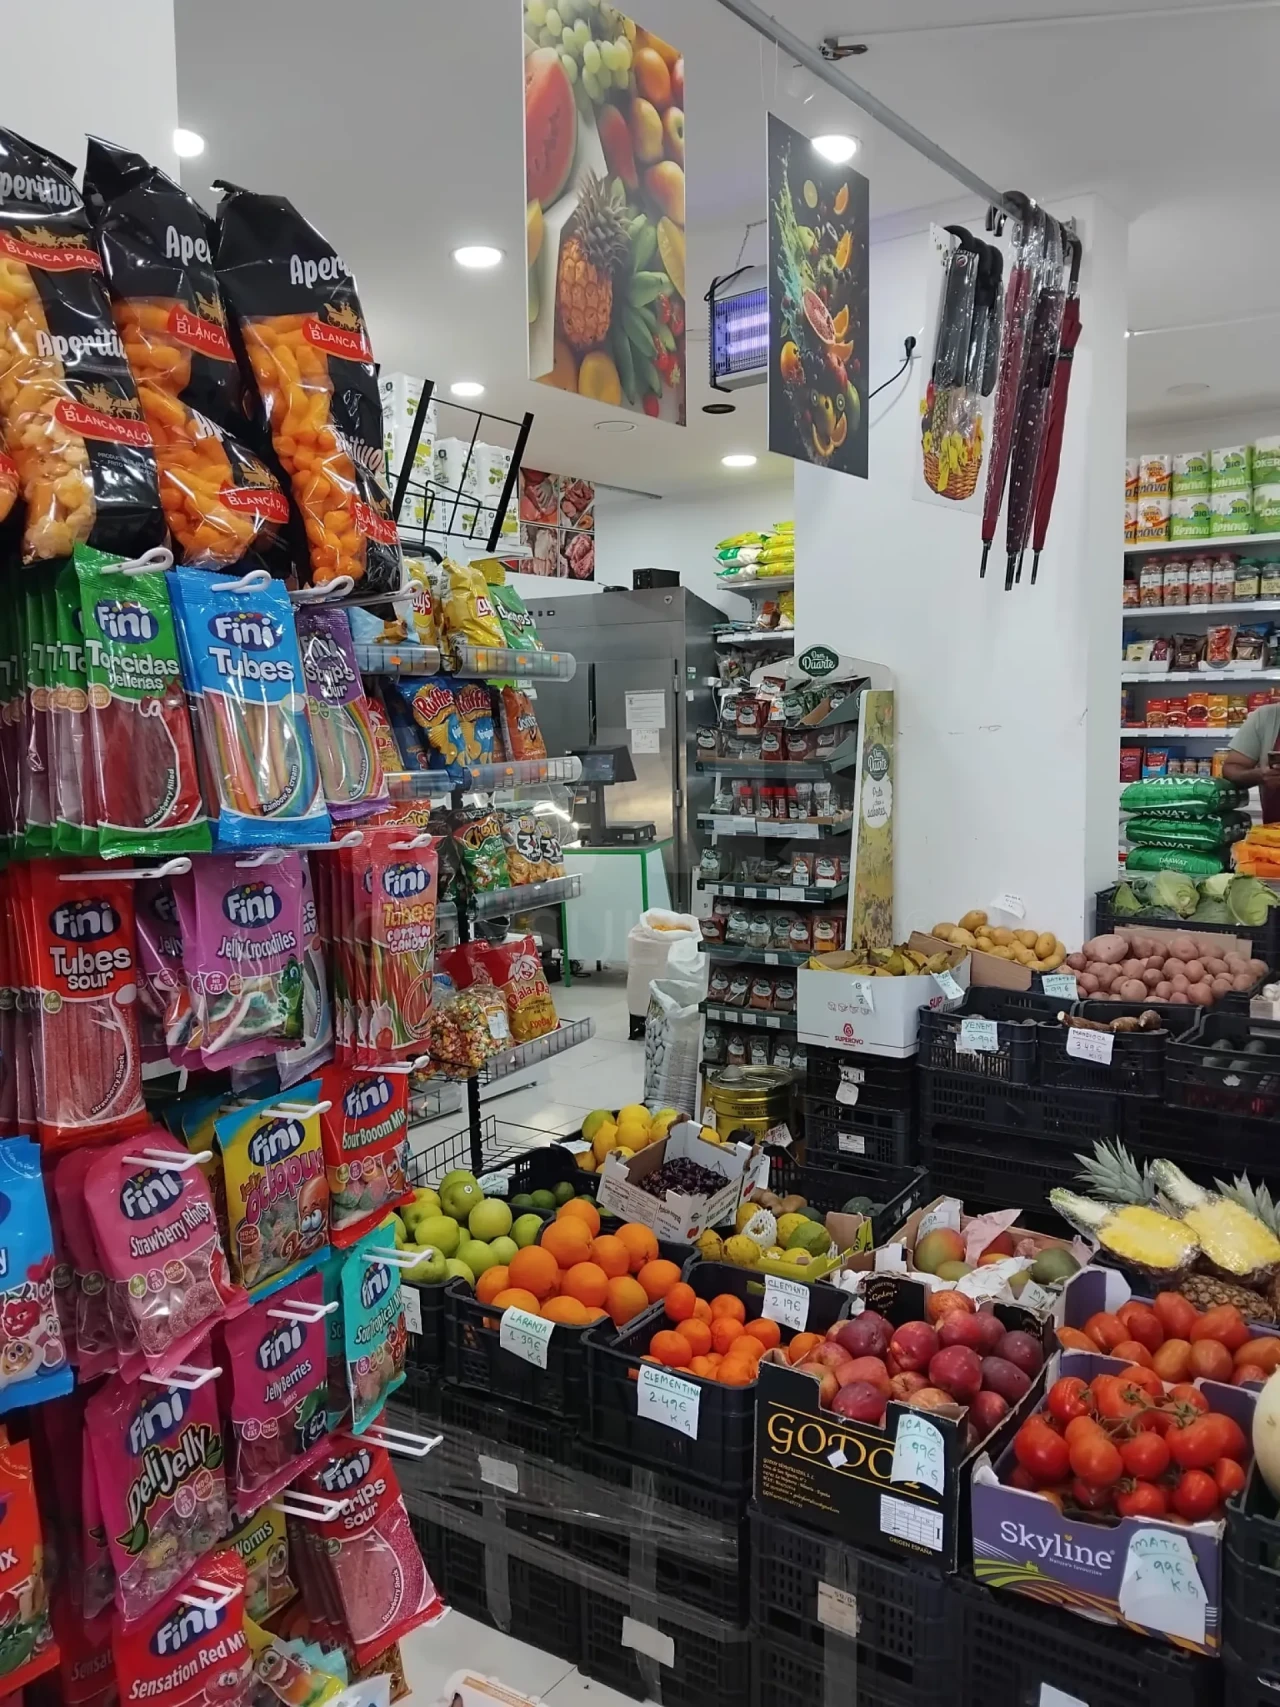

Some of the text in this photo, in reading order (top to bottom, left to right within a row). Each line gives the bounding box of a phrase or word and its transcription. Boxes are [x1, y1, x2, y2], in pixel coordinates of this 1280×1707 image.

[6, 243, 62, 262] BLANCA
[176, 313, 188, 321] LA
[309, 323, 321, 331] LA
[176, 321, 225, 347] BLANCA
[312, 330, 357, 350] BLANCA
[62, 404, 76, 412] LA
[65, 411, 115, 432] BLANCA
[228, 495, 275, 507] BLANCA
[215, 616, 274, 644] Fini
[86, 639, 180, 676] Torcidas
[209, 647, 294, 681] Tubes
[802, 656, 835, 670] Duarte
[144, 768, 175, 826] Strawberry filled
[263, 792, 289, 814] Rainbow
[289, 765, 298, 787] cream
[385, 863, 425, 894] Fini
[228, 886, 275, 923] Fini
[55, 902, 114, 938] Fini
[245, 931, 297, 960] Crocodiles
[390, 936, 428, 953] CANDY
[50, 946, 131, 976] Tubes
[68, 971, 114, 990] sour
[834, 1035, 864, 1045] SUPEROVO
[92, 1078, 121, 1115] Strawberry
[346, 1075, 390, 1116] Fini
[359, 1120, 392, 1145] Booom
[392, 1108, 407, 1128] Mix
[130, 1220, 188, 1257] Strawberry
[510, 1311, 547, 1334] LARANJA
[280, 1360, 312, 1394] Berries
[767, 1412, 921, 1490] GODO
[322, 1448, 372, 1491] Fini
[344, 1502, 379, 1530] sour
[888, 1536, 933, 1556] ORIGEN ESPAÑA
[1000, 1520, 1112, 1570] Skyline
[1073, 1564, 1103, 1576] favourites
[381, 1590, 400, 1623] Strawberry
[128, 1660, 199, 1700] Sensation
[199, 1643, 228, 1669] Red
